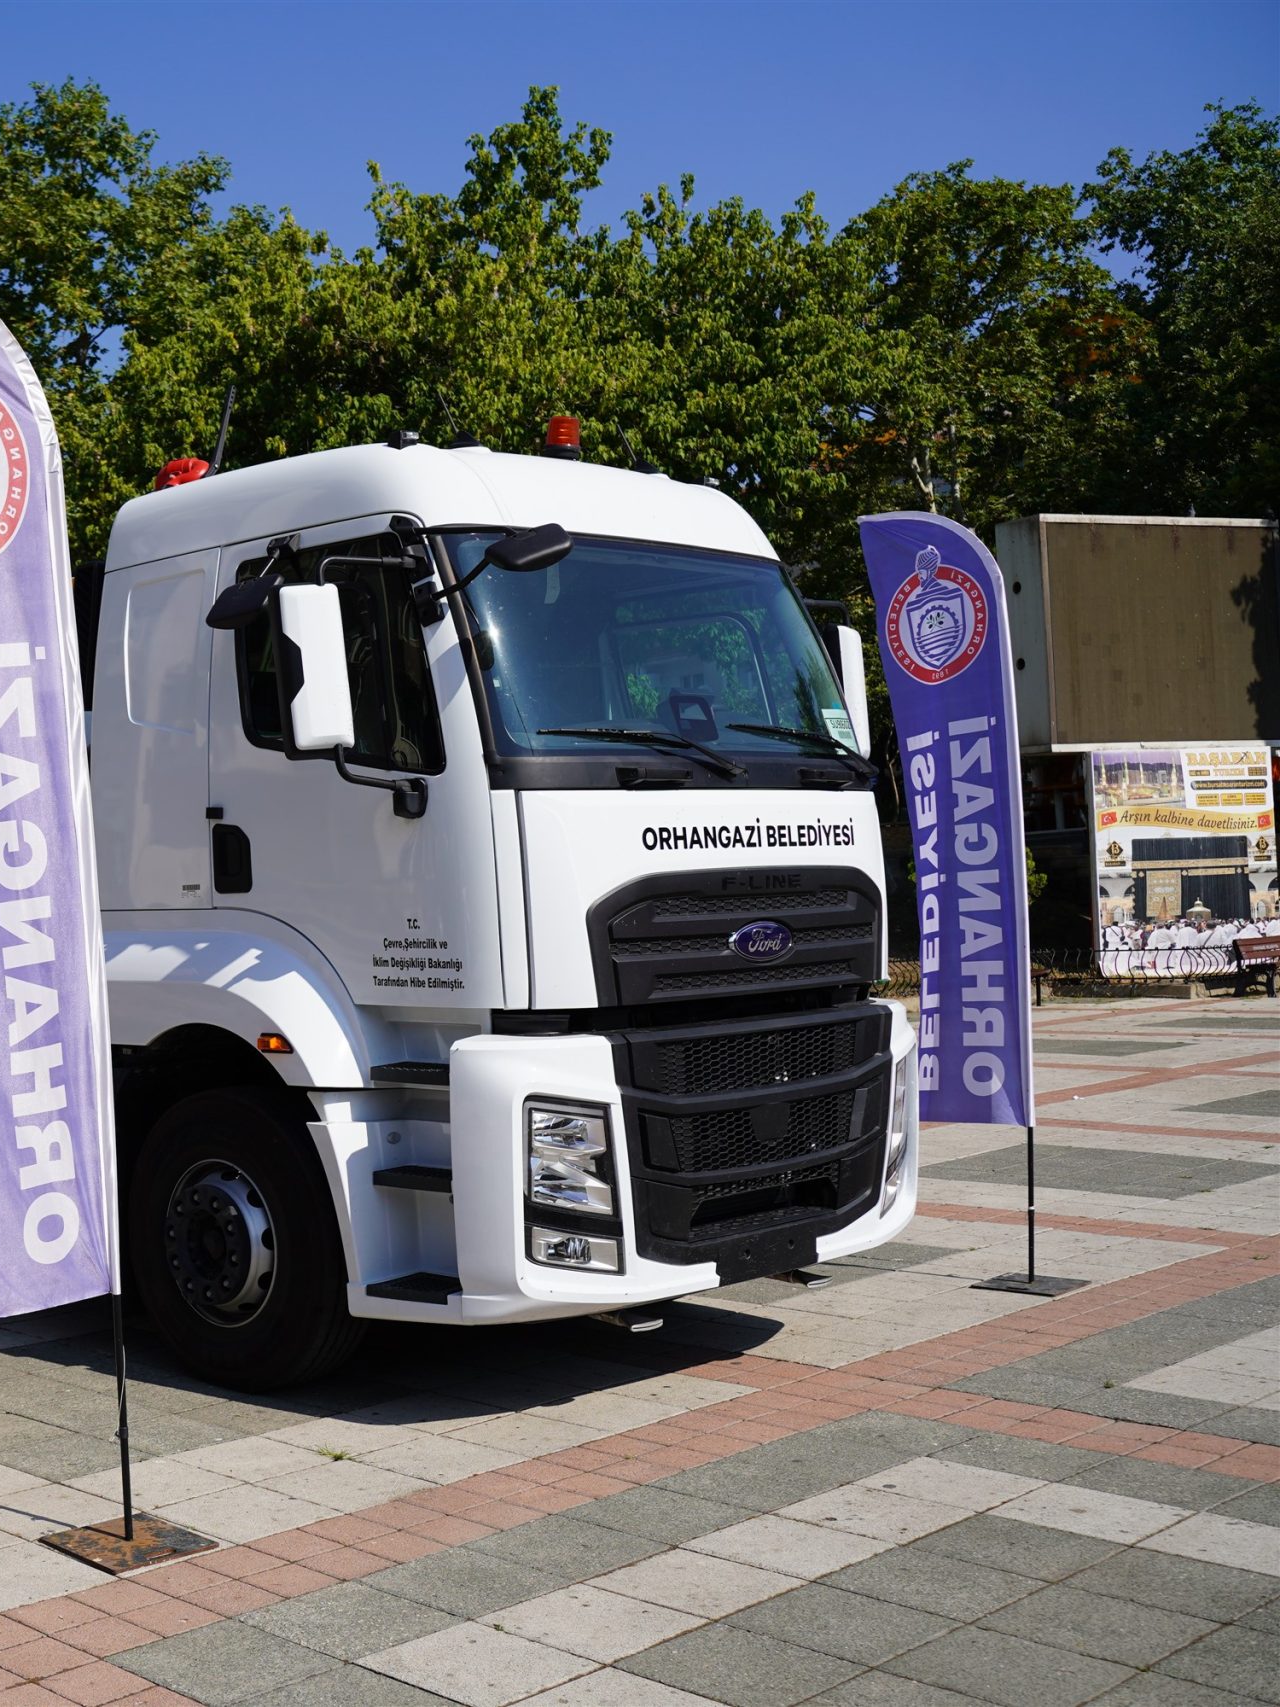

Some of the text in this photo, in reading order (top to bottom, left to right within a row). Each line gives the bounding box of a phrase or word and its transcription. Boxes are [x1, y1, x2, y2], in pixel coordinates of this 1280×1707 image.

[1185, 751, 1267, 767] BAŞARAN
[1120, 809, 1258, 830] Arşın kalbine davetlisiniz.
[642, 817, 855, 850] ORHANGAZİ BELEDİYESİ
[722, 874, 802, 891] F-LINE
[406, 918, 421, 930] T.C.
[383, 938, 448, 951] Çevre,Şehircilik ve
[748, 928, 782, 953] Ford
[372, 954, 463, 972] İklim Değişikliği Bakanlığı
[372, 975, 465, 991] Tarafından Hibe Edilmiştir.
